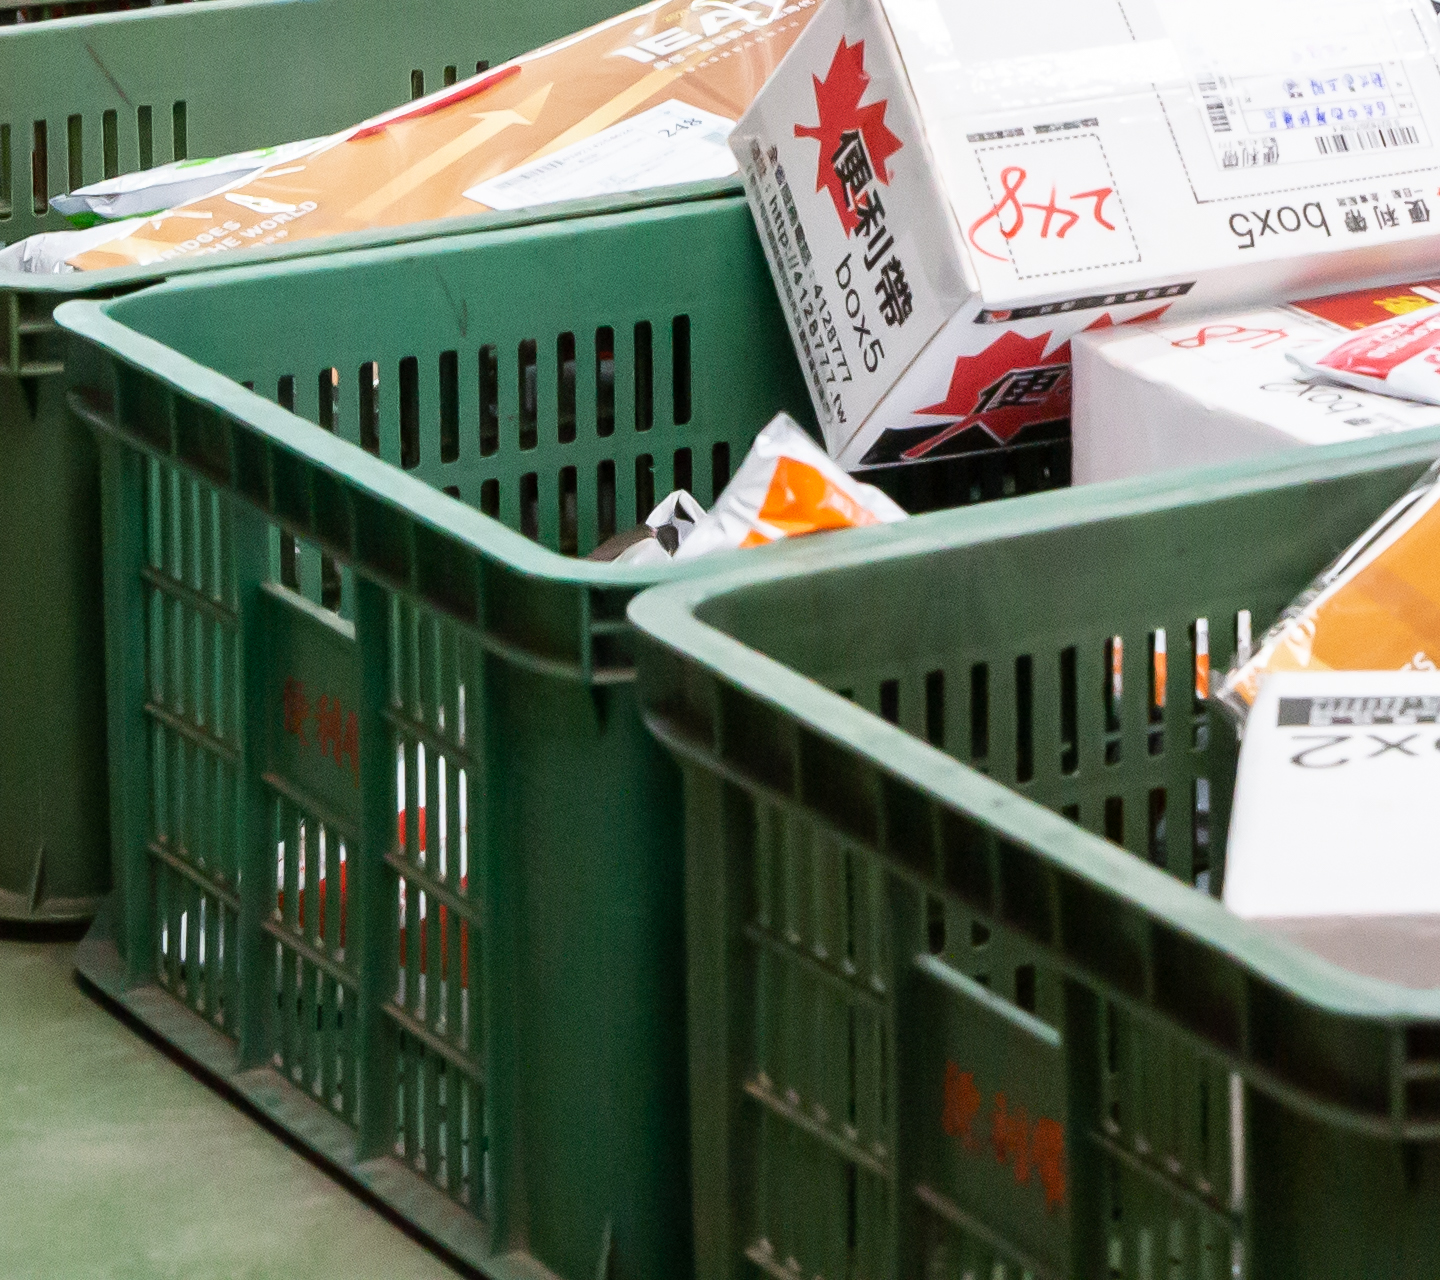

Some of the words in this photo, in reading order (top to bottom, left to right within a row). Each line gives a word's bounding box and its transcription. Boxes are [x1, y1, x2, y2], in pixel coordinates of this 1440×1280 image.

[830, 128, 914, 328] 便利帶
[968, 166, 1116, 262] 248
[1227, 200, 1332, 251] box5
[1343, 198, 1432, 234] 便利帶
[833, 252, 886, 374] box5
